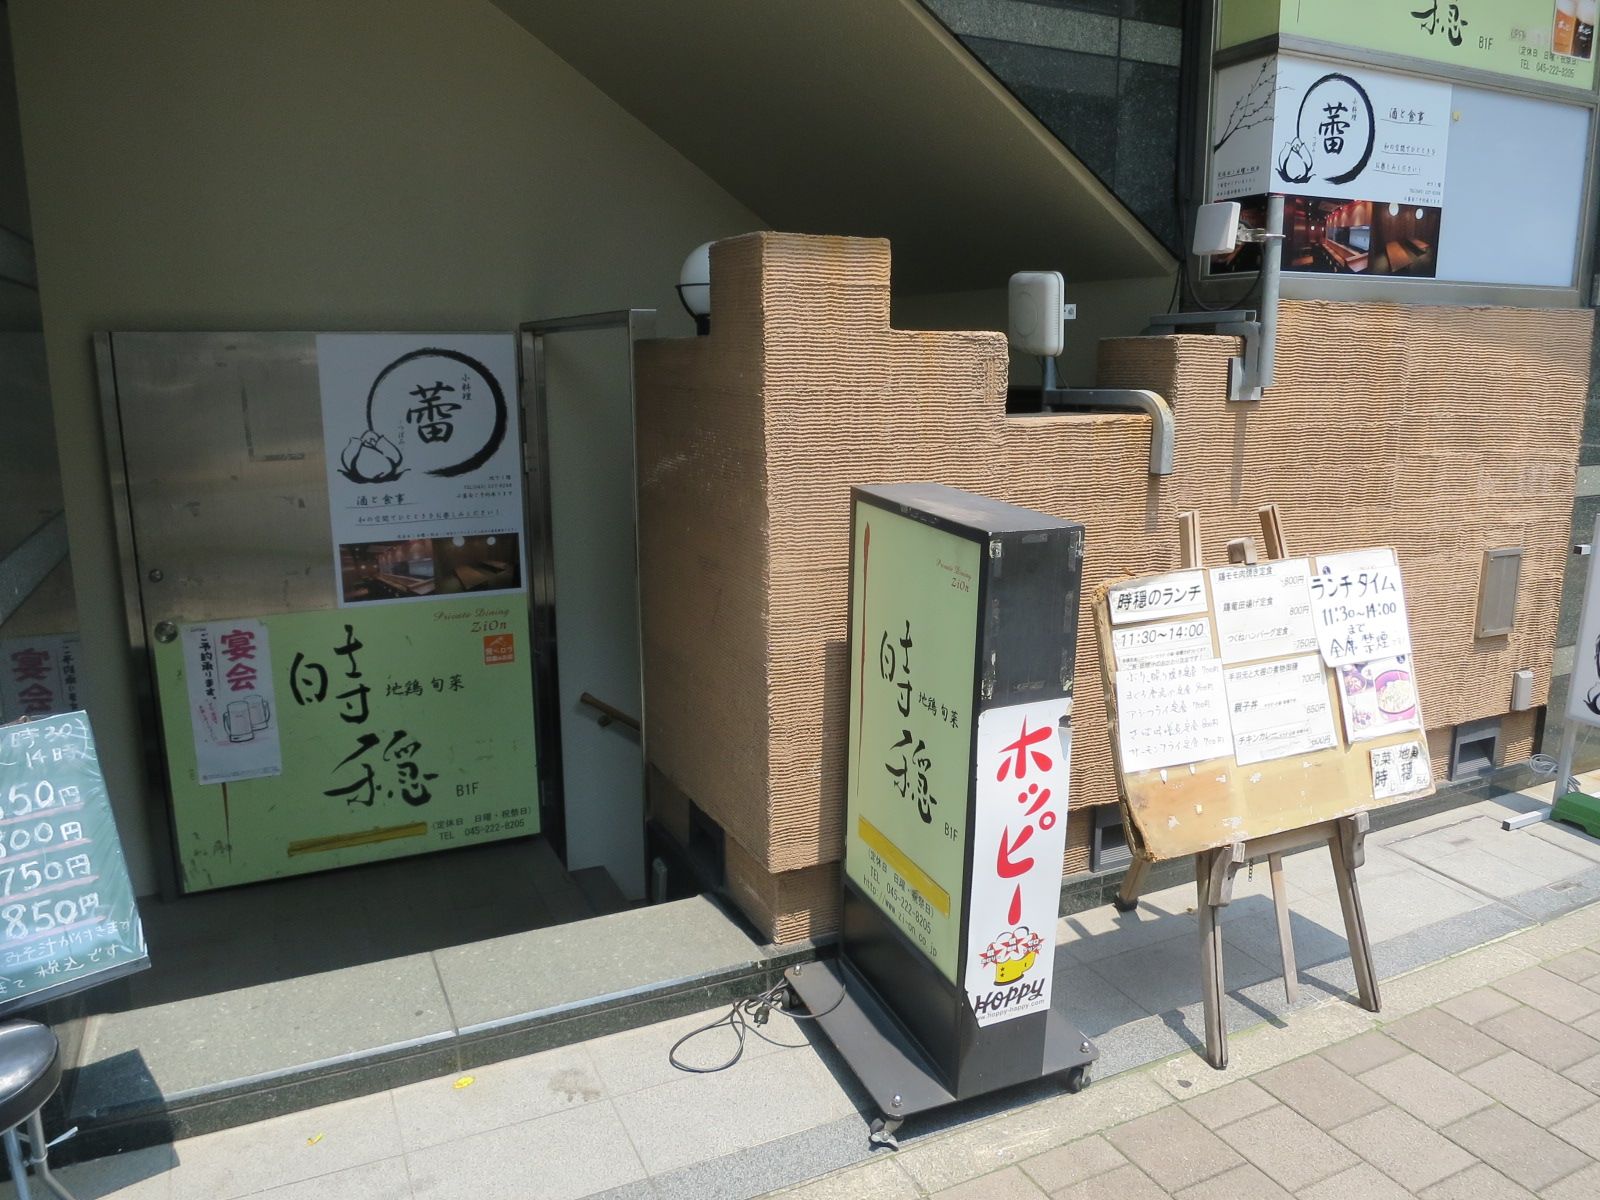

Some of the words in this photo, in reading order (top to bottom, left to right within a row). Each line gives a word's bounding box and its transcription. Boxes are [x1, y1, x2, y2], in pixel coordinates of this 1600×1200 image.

[1478, 36, 1494, 50] B1F
[1520, 59, 1531, 71] TEL
[1319, 102, 1350, 154] 蕾
[1389, 107, 1425, 125] 酒と食事
[461, 374, 472, 401] 小料理
[406, 381, 462, 444] 蕾
[356, 493, 405, 506] 酒と食事
[1117, 585, 1202, 611] 時穏のランチ
[1348, 624, 1365, 635] まで
[220, 629, 258, 692] 宴会
[1238, 731, 1278, 745] チキンカレー
[0, 780, 80, 820] 50円
[456, 781, 480, 798] B1F
[440, 831, 455, 840] TEL
[464, 819, 525, 837] 045-222-8205
[944, 822, 958, 842] B1F
[996, 714, 1056, 926] ホッピー
[0, 853, 90, 898] 750円
[870, 866, 880, 885] TEL
[886, 882, 932, 935] 045-222-8205
[2, 893, 99, 940] 850円
